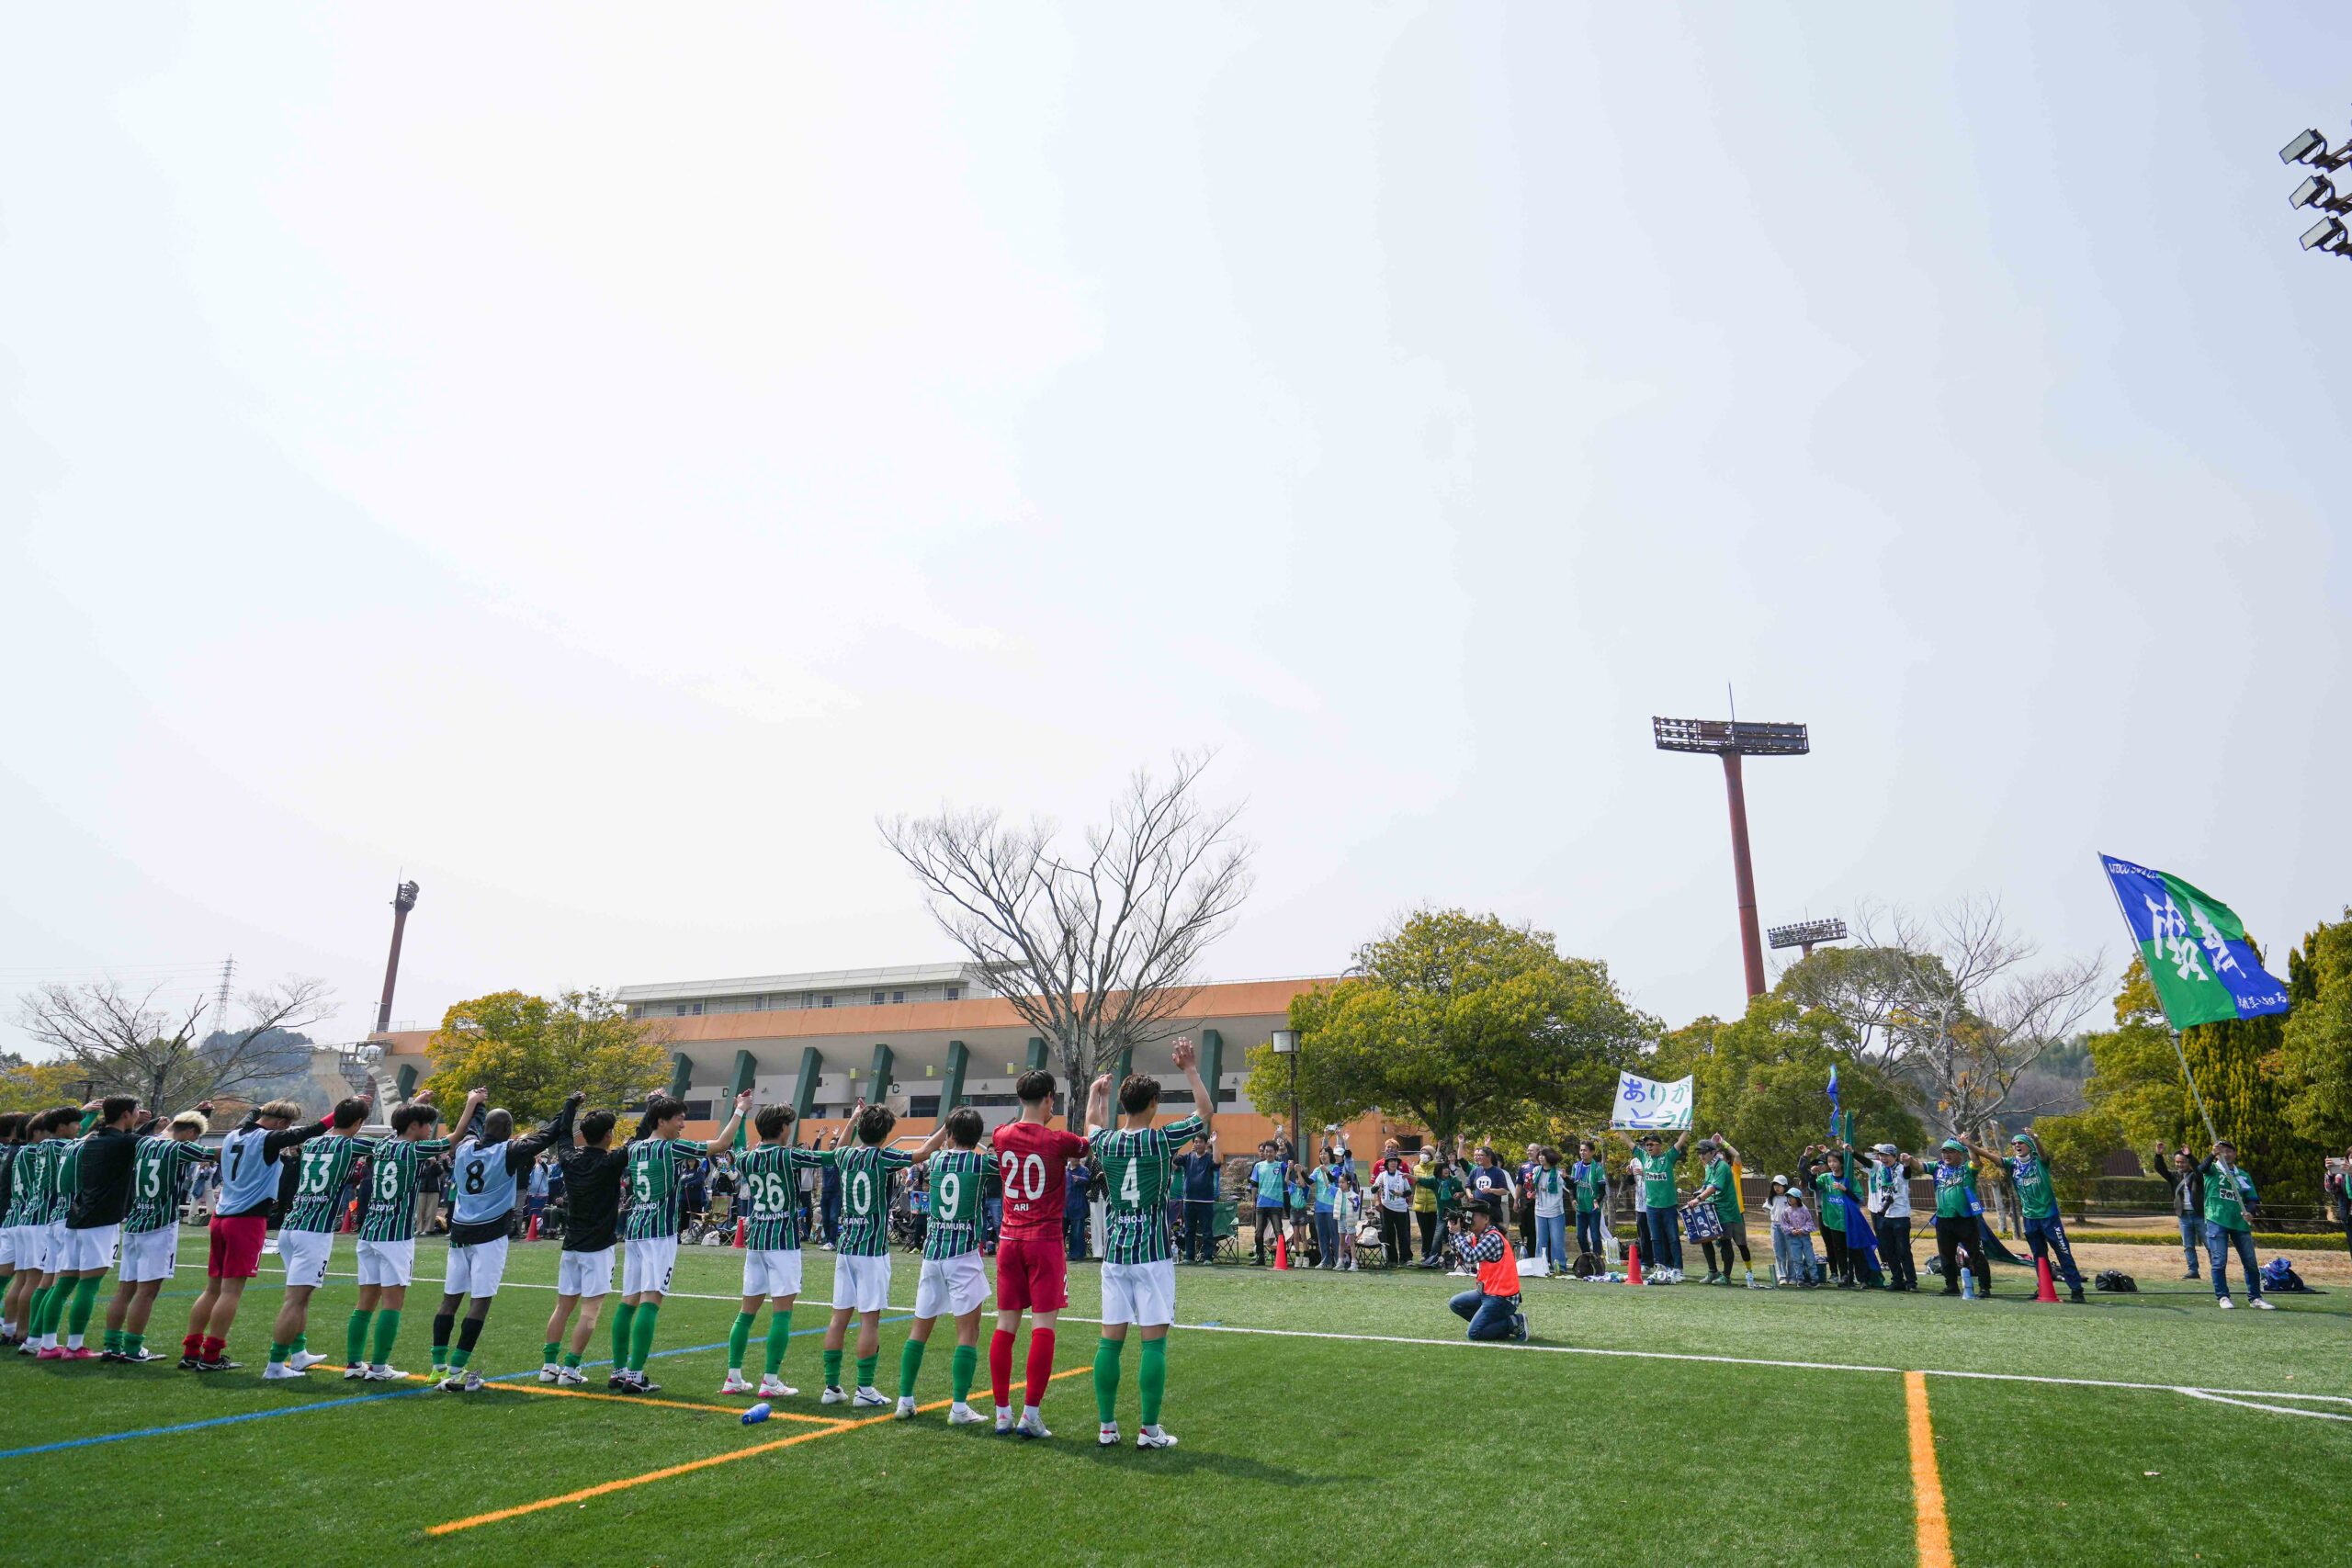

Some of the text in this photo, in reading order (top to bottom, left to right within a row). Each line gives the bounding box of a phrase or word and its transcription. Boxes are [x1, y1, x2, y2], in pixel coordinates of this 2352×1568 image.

[892, 1084, 899, 1093] C
[1623, 1078, 1690, 1107] ありが
[135, 1158, 161, 1198] 13
[231, 1145, 244, 1181] 7
[299, 1153, 334, 1193] 33
[372, 1159, 398, 1200] 18
[466, 1159, 485, 1194] 8
[638, 1161, 650, 1201] 5
[1001, 1150, 1046, 1201] 20
[1121, 1157, 1140, 1208] 4
[749, 1172, 785, 1213] 26
[842, 1170, 871, 1215] 10
[939, 1173, 960, 1220] 9
[1117, 1214, 1147, 1224] SHOJI
[663, 1267, 673, 1285] 5
